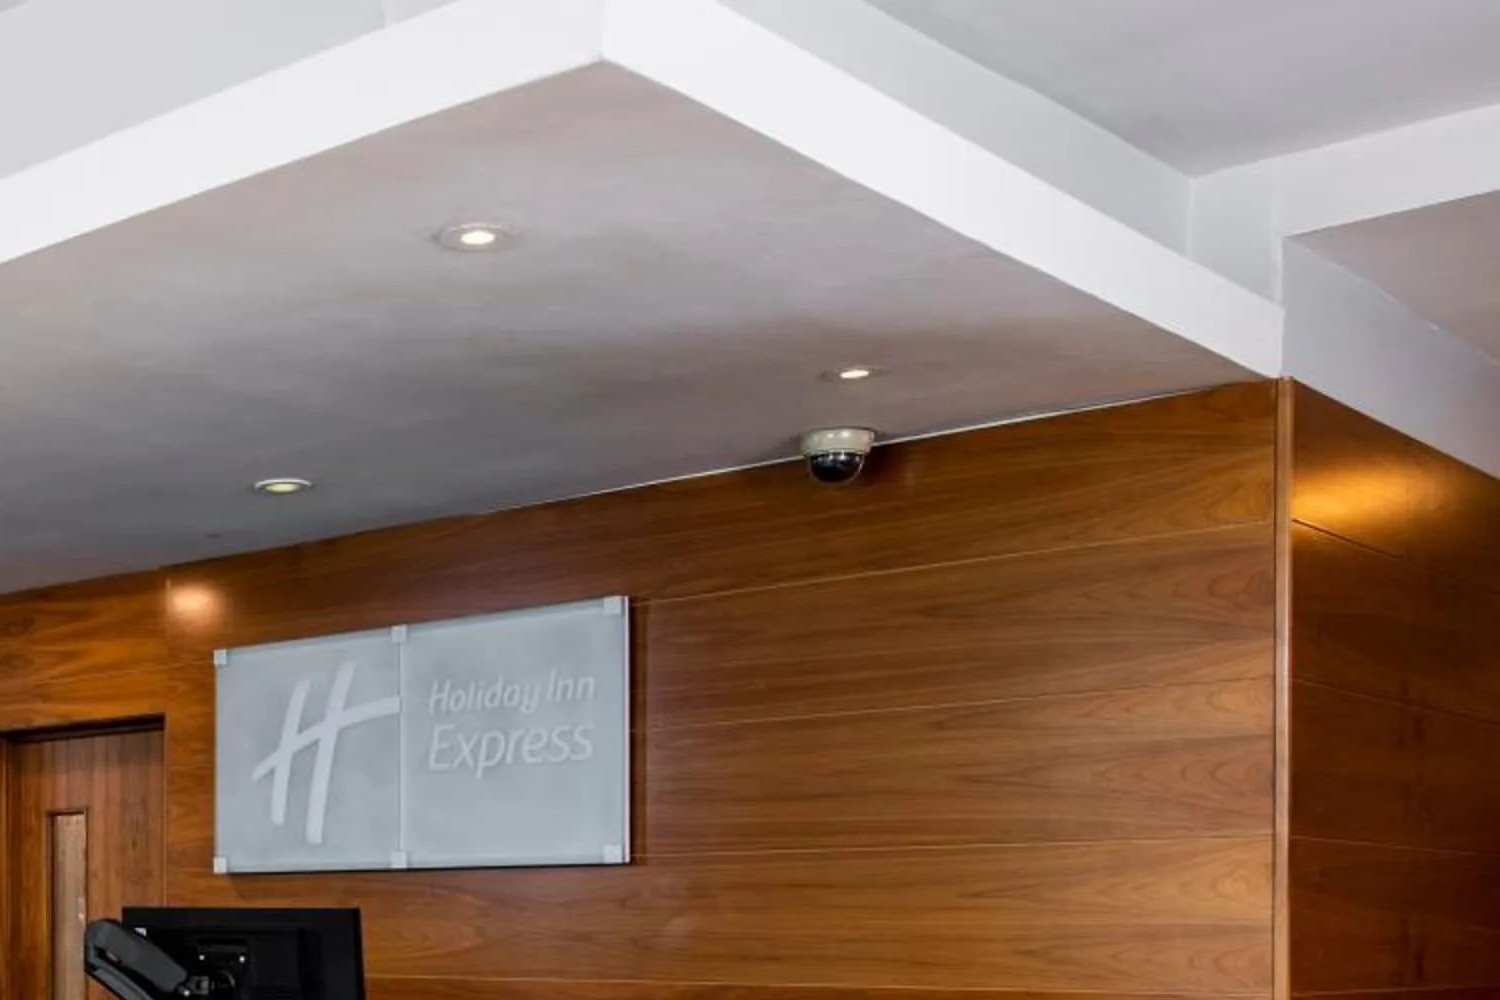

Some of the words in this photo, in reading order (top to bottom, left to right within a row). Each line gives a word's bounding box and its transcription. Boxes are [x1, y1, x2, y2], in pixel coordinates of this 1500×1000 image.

[429, 674, 541, 714] Holiday
[547, 668, 595, 703] Inn
[428, 723, 595, 780] Express
